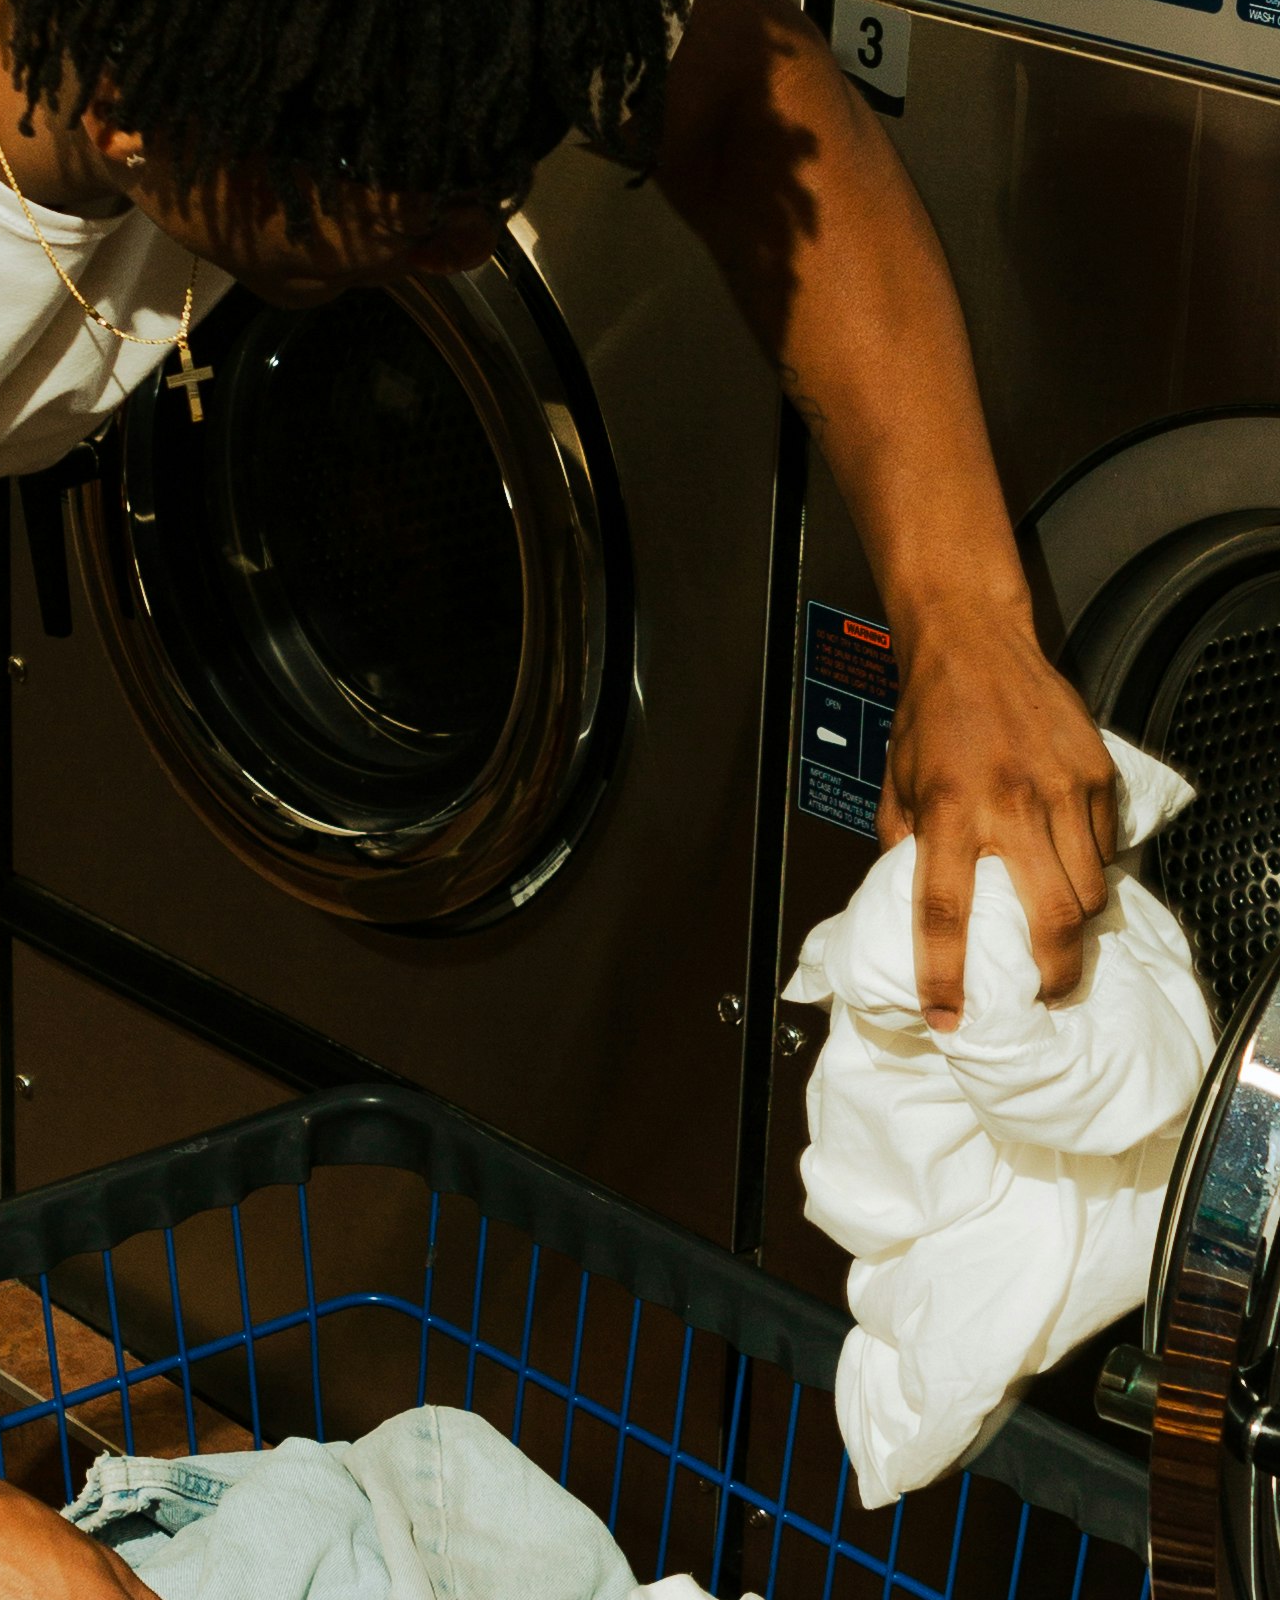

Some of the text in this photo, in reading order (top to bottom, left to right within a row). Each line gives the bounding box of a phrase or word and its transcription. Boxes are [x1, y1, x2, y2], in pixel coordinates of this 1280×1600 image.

[1249, 9, 1274, 24] WASH
[857, 16, 884, 70] 3
[847, 623, 887, 646] WARNING
[825, 697, 841, 711] OPEN
